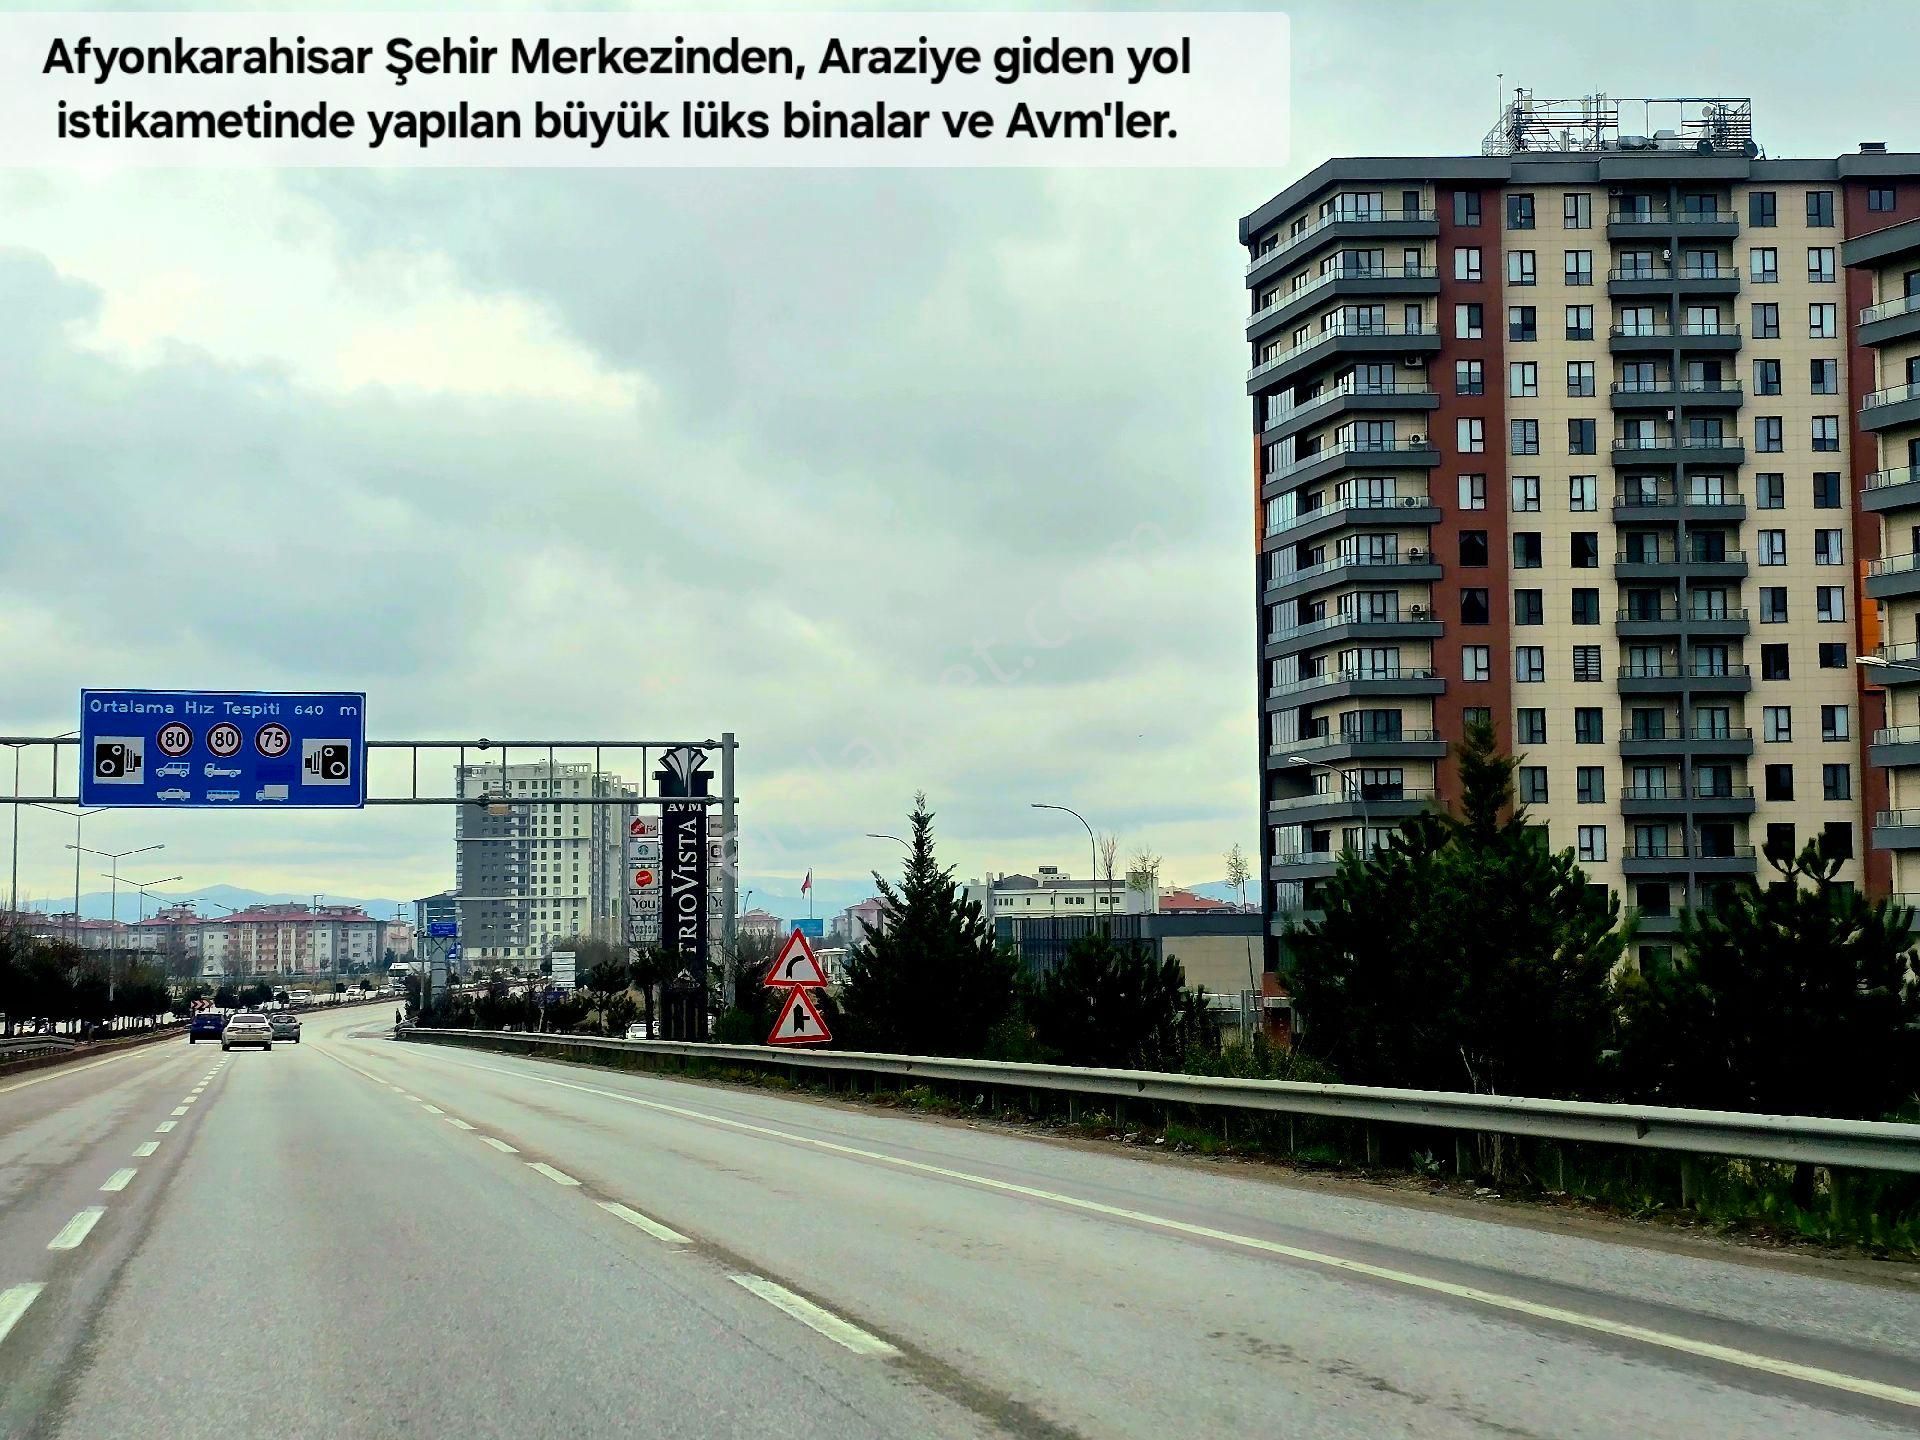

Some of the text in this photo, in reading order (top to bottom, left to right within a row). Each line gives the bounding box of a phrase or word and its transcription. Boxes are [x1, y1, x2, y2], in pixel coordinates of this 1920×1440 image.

[90, 699, 357, 719] Ortalama Hız Tespiti 640 m
[165, 731, 284, 748] 80 80 75
